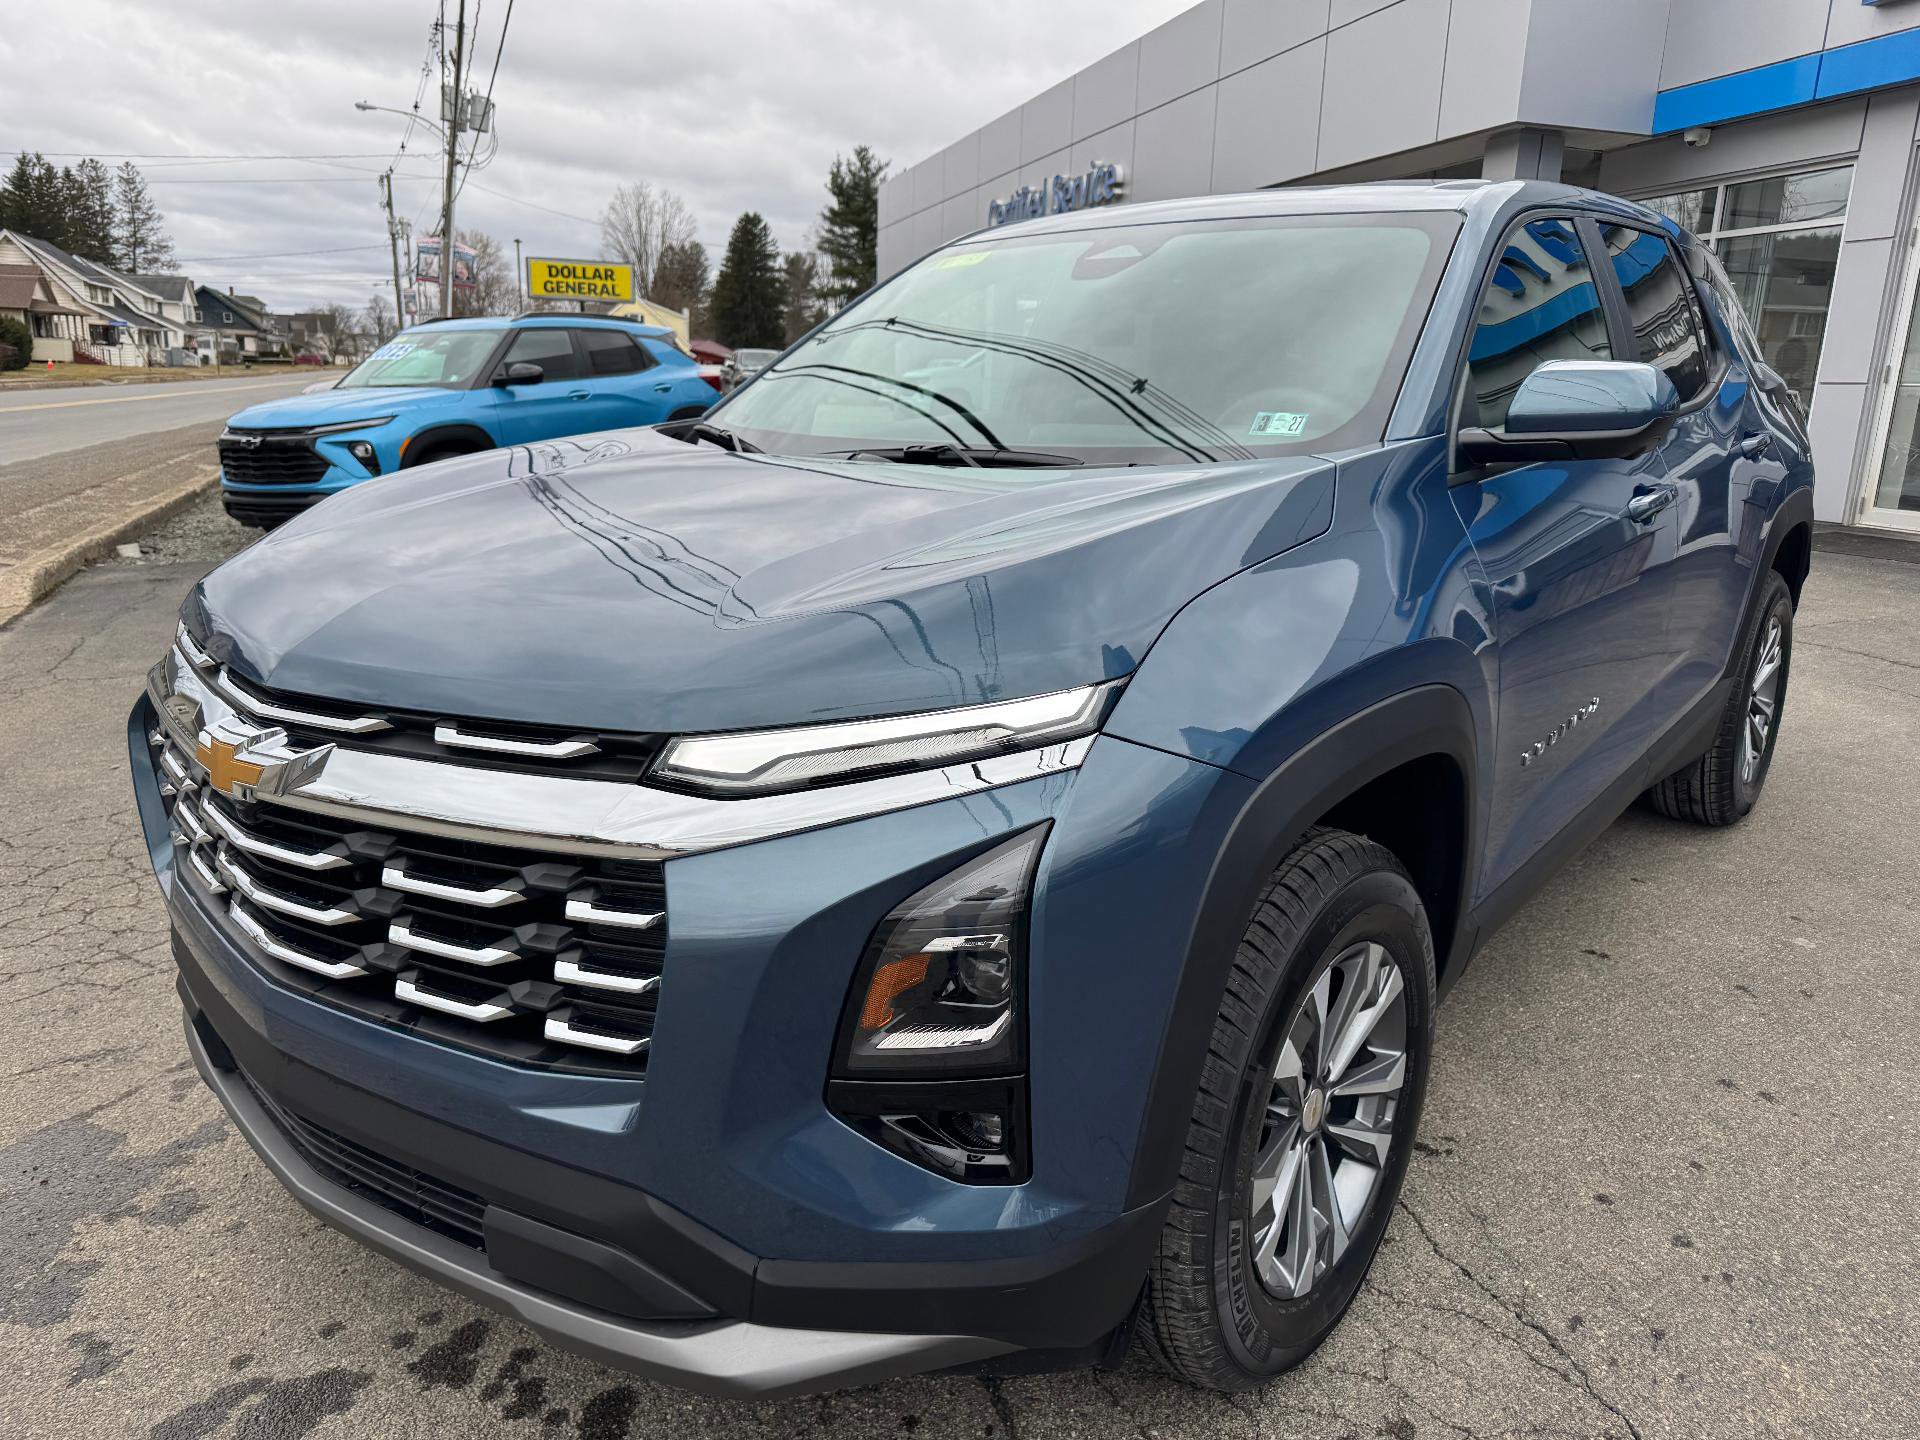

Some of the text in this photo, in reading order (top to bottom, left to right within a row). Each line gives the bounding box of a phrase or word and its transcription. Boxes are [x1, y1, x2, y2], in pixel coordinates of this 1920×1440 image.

[1052, 160, 1124, 213] Service
[547, 265, 615, 281] DOLLAR
[543, 280, 621, 296] GENERAL
[1287, 415, 1305, 432] 27
[1230, 1226, 1257, 1345] MICHELIN
